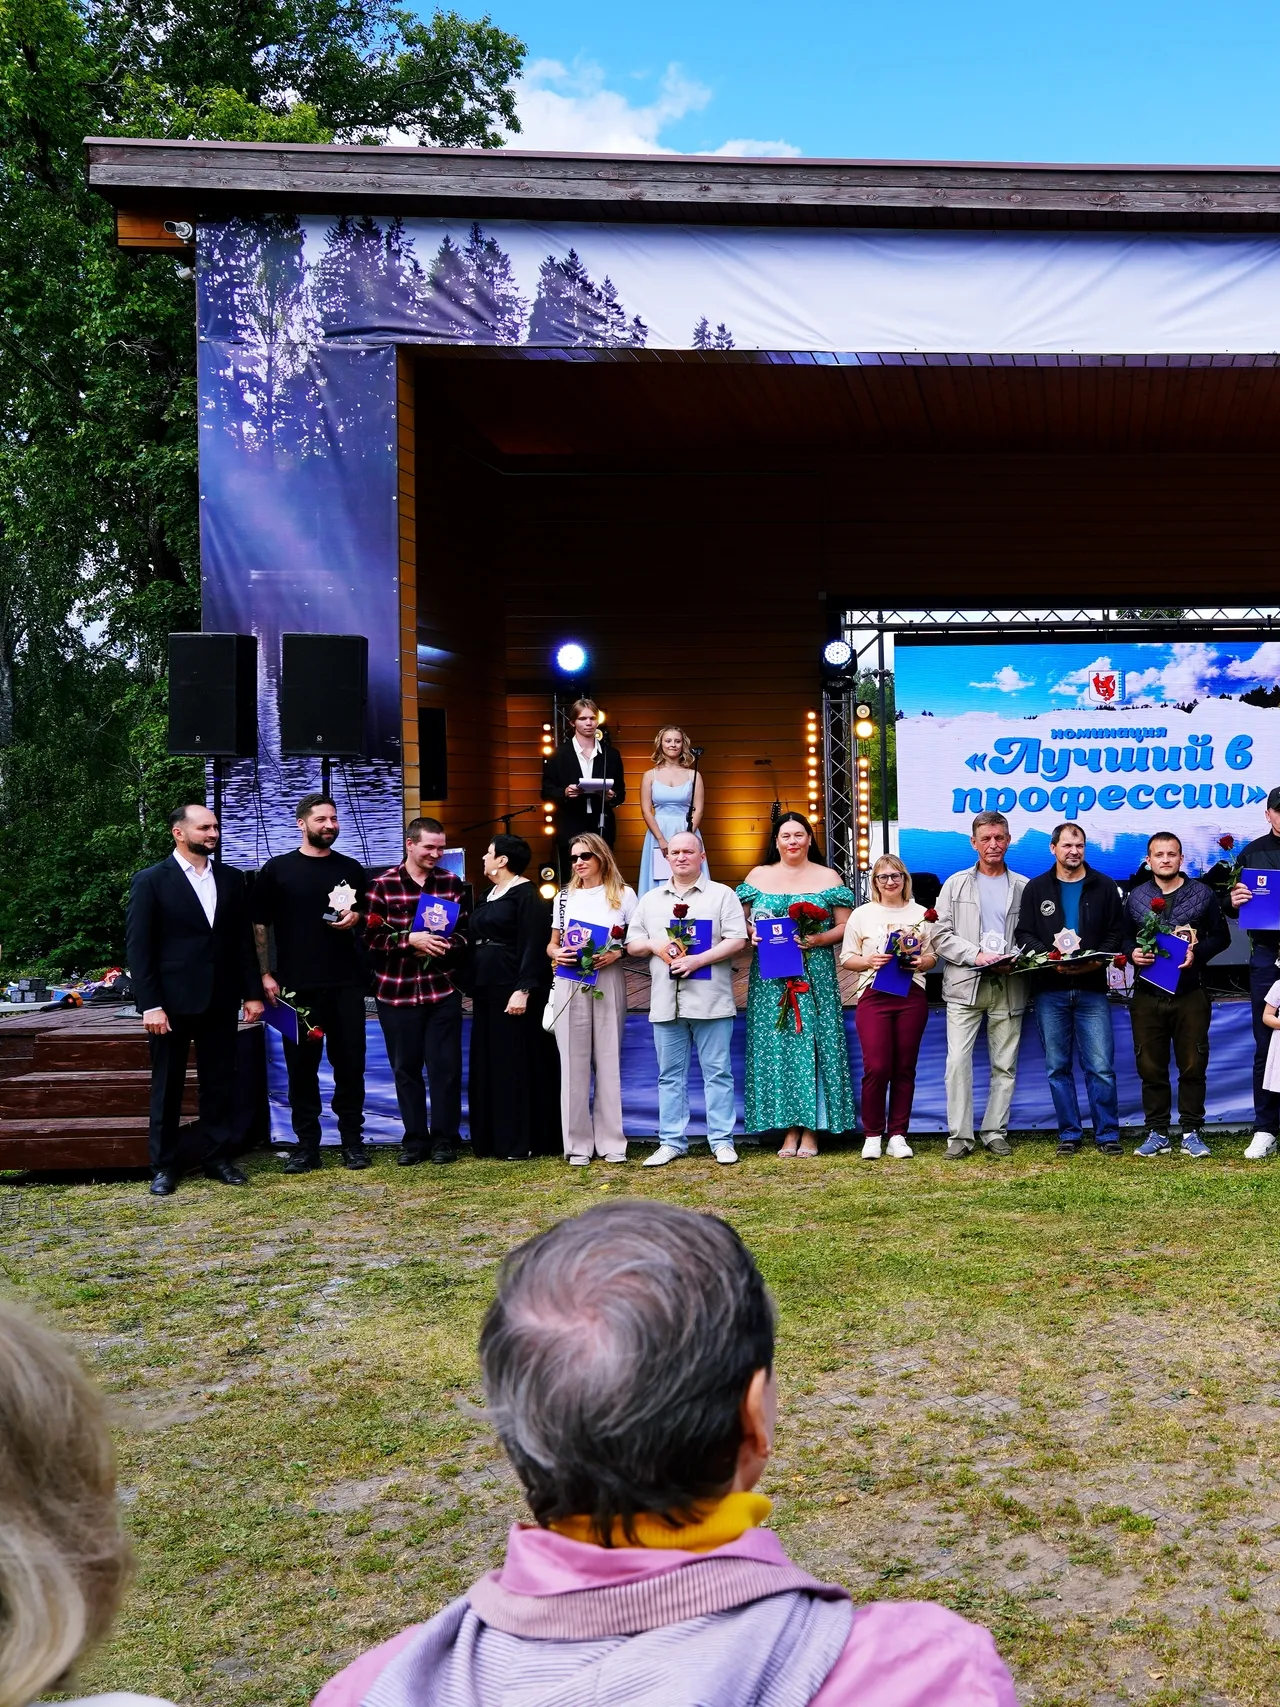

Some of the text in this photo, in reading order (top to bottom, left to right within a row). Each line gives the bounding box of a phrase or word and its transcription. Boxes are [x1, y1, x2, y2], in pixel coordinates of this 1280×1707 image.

[1051, 727, 1168, 742] номинация
[964, 734, 1254, 782] «Лучший в
[952, 783, 1268, 819] профессии»
